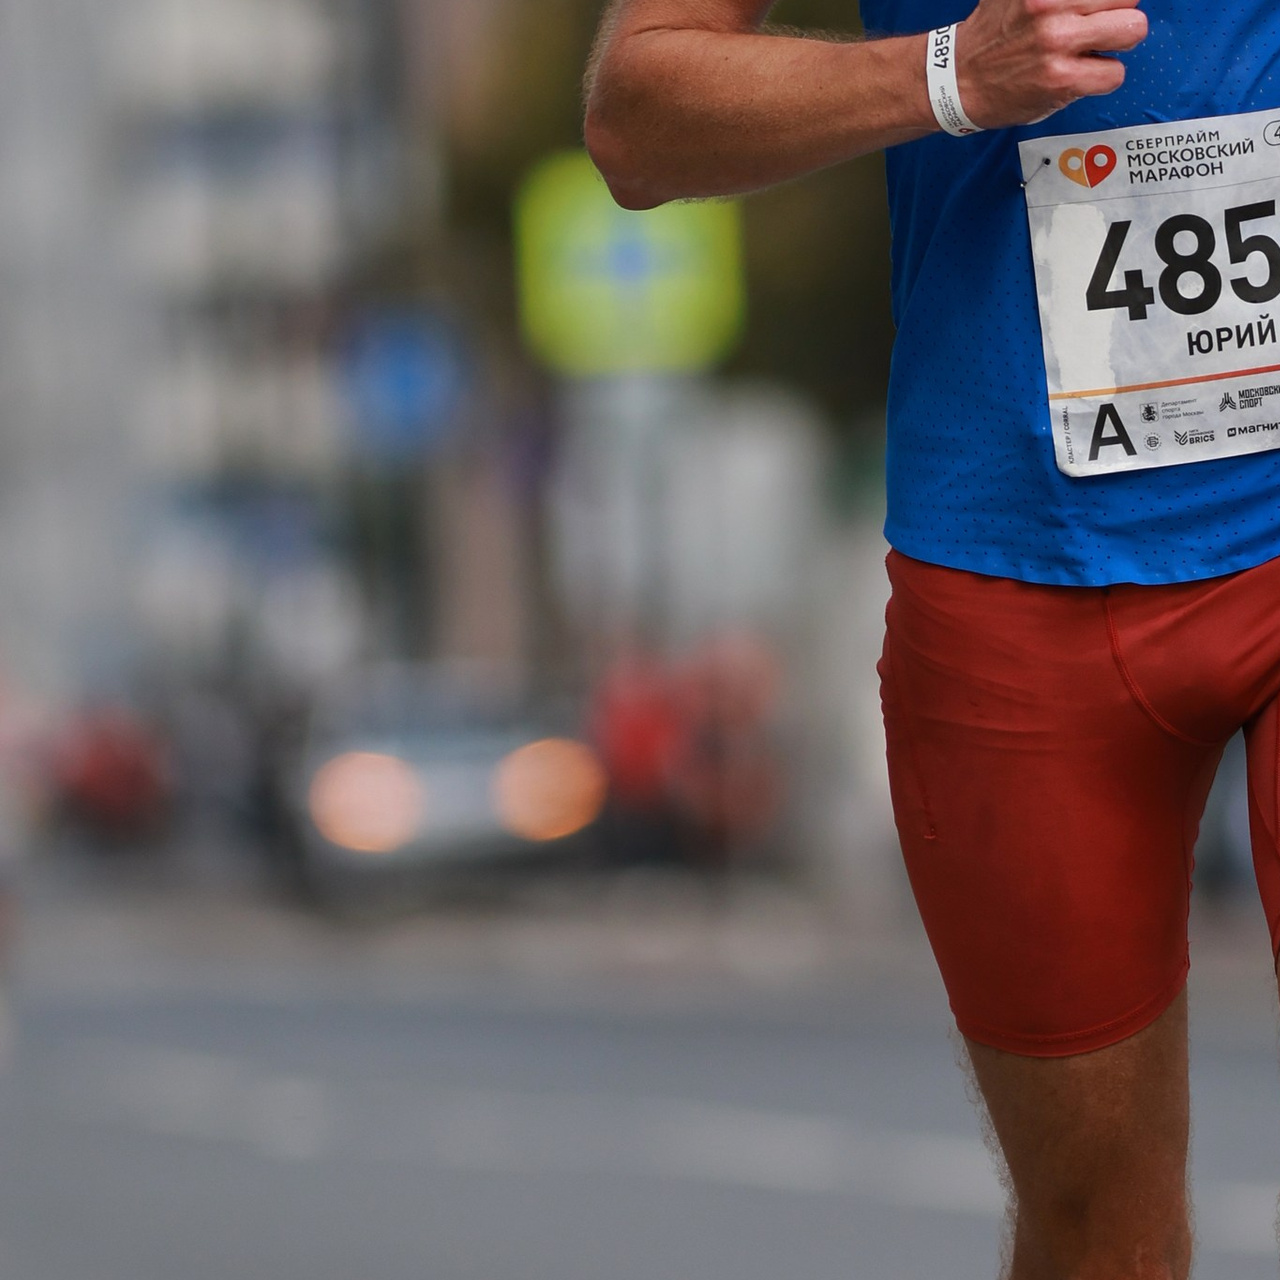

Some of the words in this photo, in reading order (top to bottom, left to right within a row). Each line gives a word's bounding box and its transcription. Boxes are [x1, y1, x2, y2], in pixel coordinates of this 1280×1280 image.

[1126, 130, 1220, 151] СБЕРПРАЙМ
[1127, 138, 1255, 167] МОСКОВСКИЙ
[1129, 161, 1224, 184] МАРАФОН
[1186, 313, 1277, 356] ЮРИЙ
[1239, 397, 1264, 410] СПОРТ
[1067, 435, 1075, 465] КЛАСТЕР
[1189, 434, 1215, 445] BRICS
